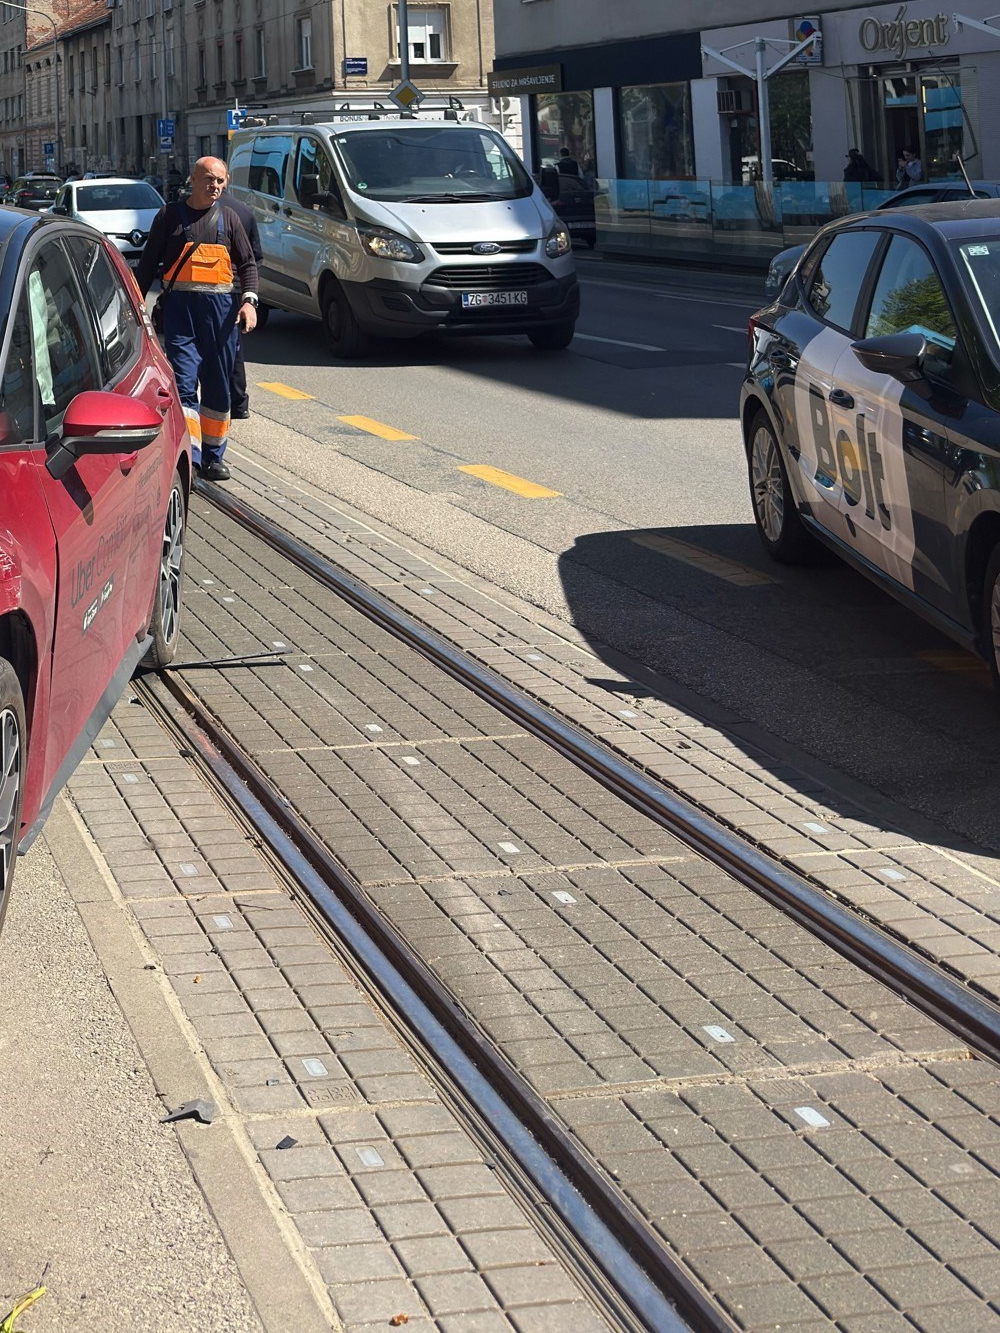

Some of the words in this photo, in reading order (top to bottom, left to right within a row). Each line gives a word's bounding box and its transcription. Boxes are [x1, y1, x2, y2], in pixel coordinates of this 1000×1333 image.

[492, 79, 510, 89] STUDIO
[511, 78, 518, 87] ZA
[519, 74, 555, 86] MRŠAVLJENJE
[469, 294, 482, 306] ZG
[809, 382, 892, 531] Bolt
[71, 560, 96, 608] Uber
